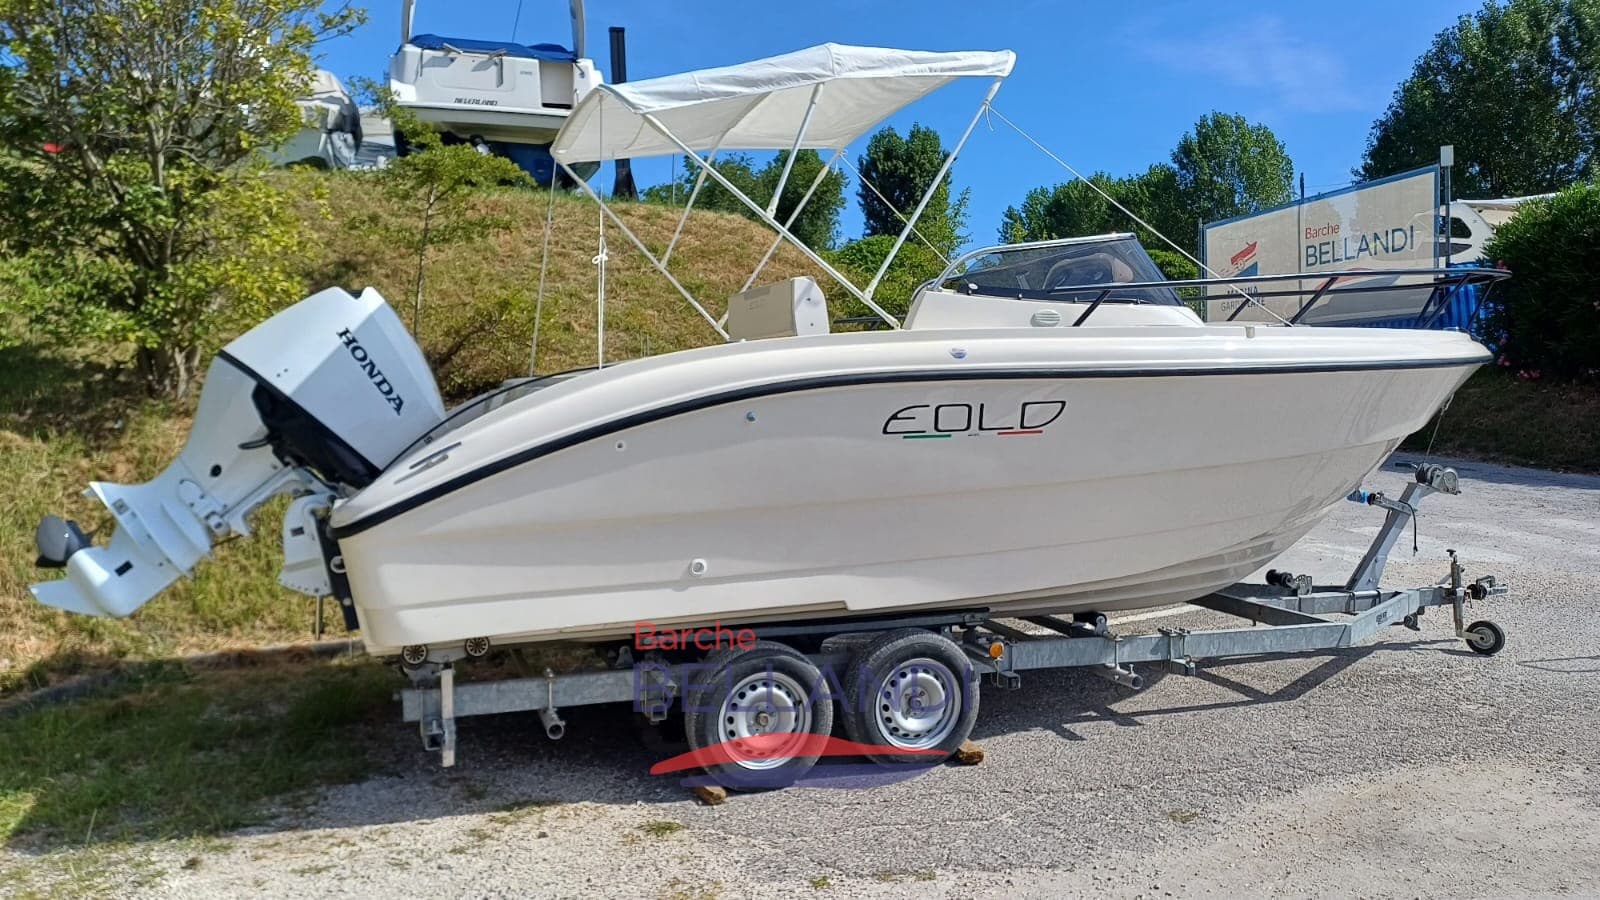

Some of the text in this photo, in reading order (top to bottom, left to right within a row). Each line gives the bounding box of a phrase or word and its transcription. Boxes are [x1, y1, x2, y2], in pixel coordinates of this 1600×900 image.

[1305, 222, 1340, 240] Barche
[1305, 225, 1414, 266] BELLANDI
[336, 327, 404, 416] HONDA
